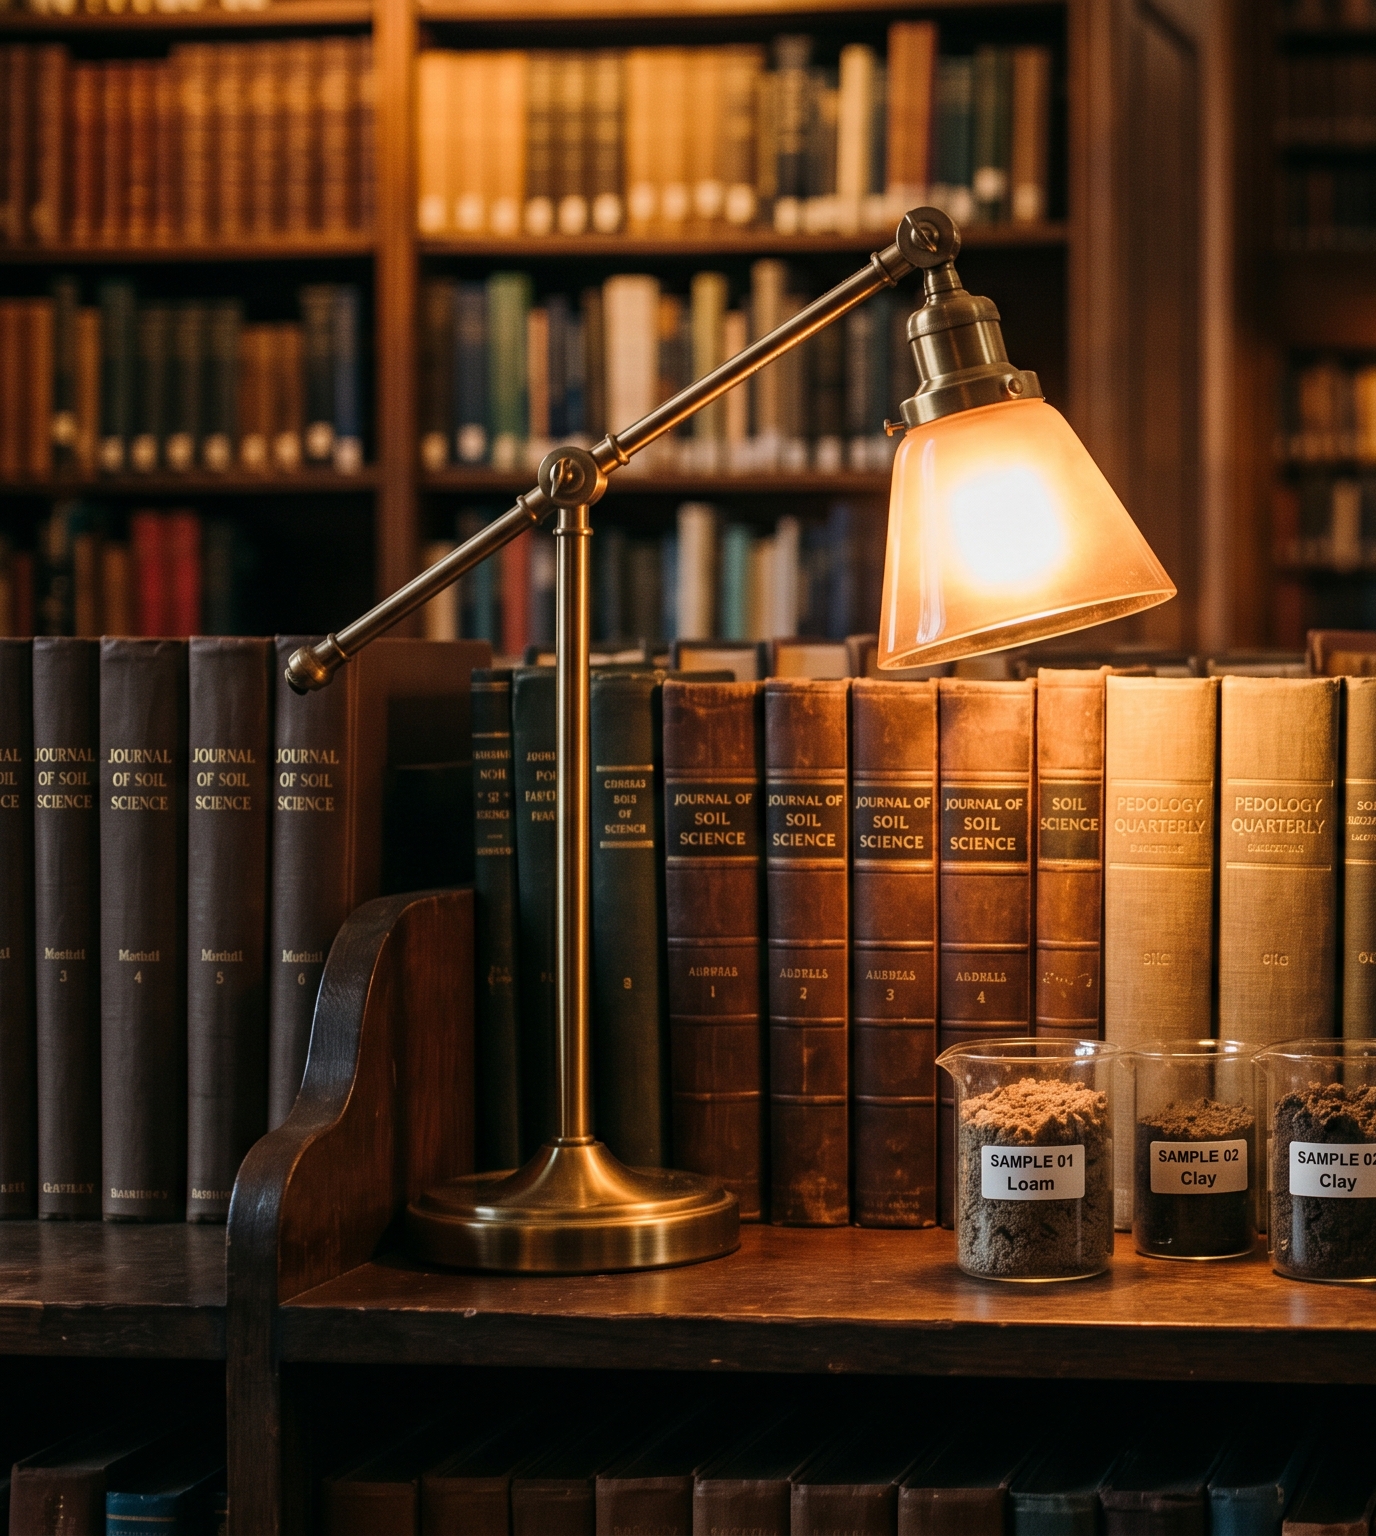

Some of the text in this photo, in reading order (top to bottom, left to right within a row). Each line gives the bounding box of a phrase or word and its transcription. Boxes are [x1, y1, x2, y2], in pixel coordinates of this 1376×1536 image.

[34, 748, 95, 762] JOURNAL
[108, 749, 172, 764] JOURNAL
[193, 749, 255, 763] JOURNAL
[276, 749, 339, 763] JOURNAL
[38, 771, 90, 785] OF SOIL
[112, 772, 167, 787] OF SOIL
[197, 772, 250, 786] OF SOIL
[279, 772, 333, 787] OF SOIL
[37, 794, 92, 808] SCIENCE
[110, 796, 168, 810] SCIENCE
[195, 796, 251, 810] SCIENCE
[277, 796, 334, 811] SCIENCE
[675, 794, 752, 805] JOURNAL OF
[769, 795, 843, 806] JOURNAL OF
[856, 796, 931, 809] JOURNAL OF
[945, 799, 1023, 811] JOURNAL OF
[1052, 797, 1087, 811] SOIL
[1117, 797, 1203, 813] PEDOLOGY
[1235, 797, 1322, 813] PEDOLOGY
[694, 812, 730, 825] SOIL
[786, 814, 821, 827] SOIL
[873, 816, 909, 829] SOIL
[964, 817, 1000, 830] SOIL
[1041, 818, 1098, 831] SCIENCE
[1114, 818, 1205, 836] QUARTERLY
[1231, 818, 1325, 836] QUARTERLY
[680, 832, 745, 845] SCIENCE
[773, 833, 836, 847] SCIENCE
[860, 835, 924, 849] SCIENCE
[950, 837, 1015, 850] SCIENCE
[60, 970, 67, 983] 3
[134, 971, 142, 983] 4
[216, 972, 224, 984] 5
[298, 973, 305, 985] 6
[710, 986, 715, 998] 1
[800, 987, 807, 1000] 2
[886, 989, 894, 1001] 3
[977, 991, 985, 1003] 4
[991, 1154, 1074, 1169] SAMPLE 01
[1158, 1149, 1239, 1163] SAMPLE 02
[1297, 1150, 1360, 1166] SAMPLE
[1007, 1176, 1055, 1191] Loam
[1180, 1170, 1217, 1188] Clay
[1319, 1173, 1357, 1192] Clay
